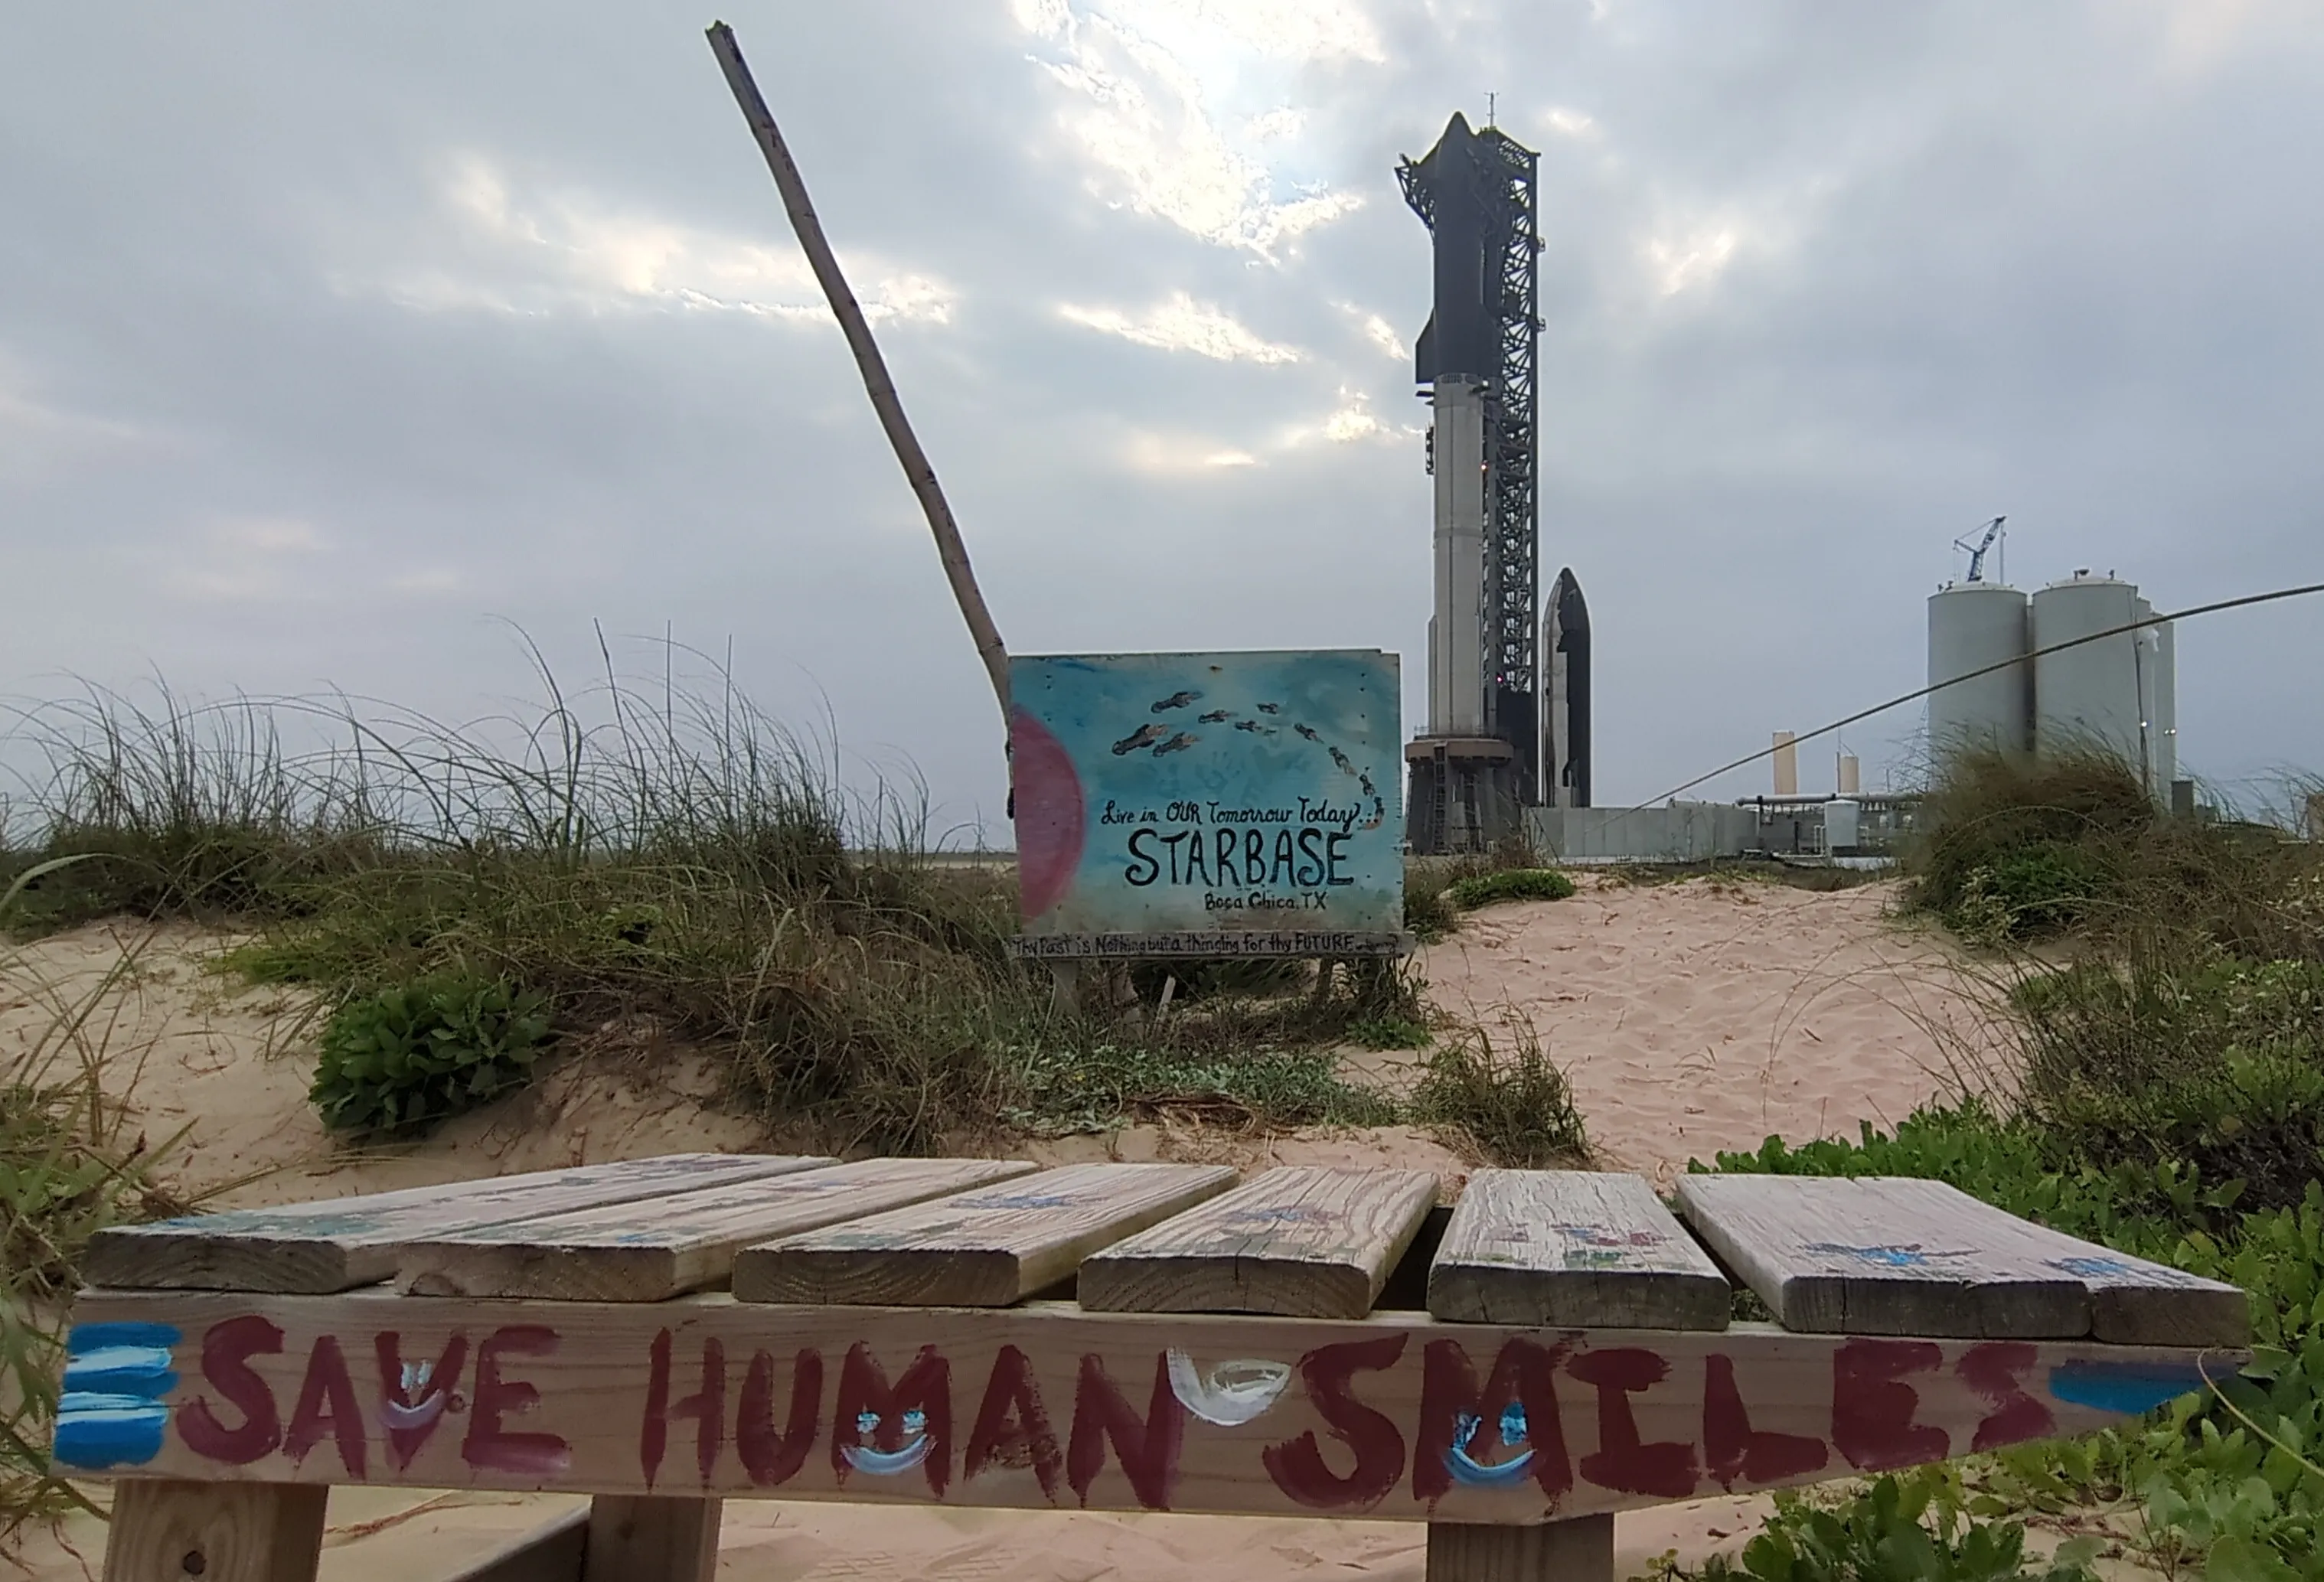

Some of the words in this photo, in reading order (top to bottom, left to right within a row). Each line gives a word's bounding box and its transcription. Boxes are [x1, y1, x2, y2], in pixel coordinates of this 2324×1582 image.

[1101, 800, 1134, 824] Live
[1140, 807, 1159, 823] in
[1166, 800, 1203, 825] OUR
[1206, 801, 1293, 824] Tomorrow
[1124, 828, 1354, 886] STARBASE
[1204, 892, 1243, 911] Boca
[1301, 891, 1327, 910] TX
[1076, 935, 1092, 954] is
[1095, 933, 1147, 955] Nothing
[1242, 933, 1265, 951] for
[1269, 932, 1292, 953] thy
[176, 1315, 571, 1482] SAVE
[640, 1326, 1186, 1512] HUMAN
[1262, 1332, 2059, 1519] SMILES
